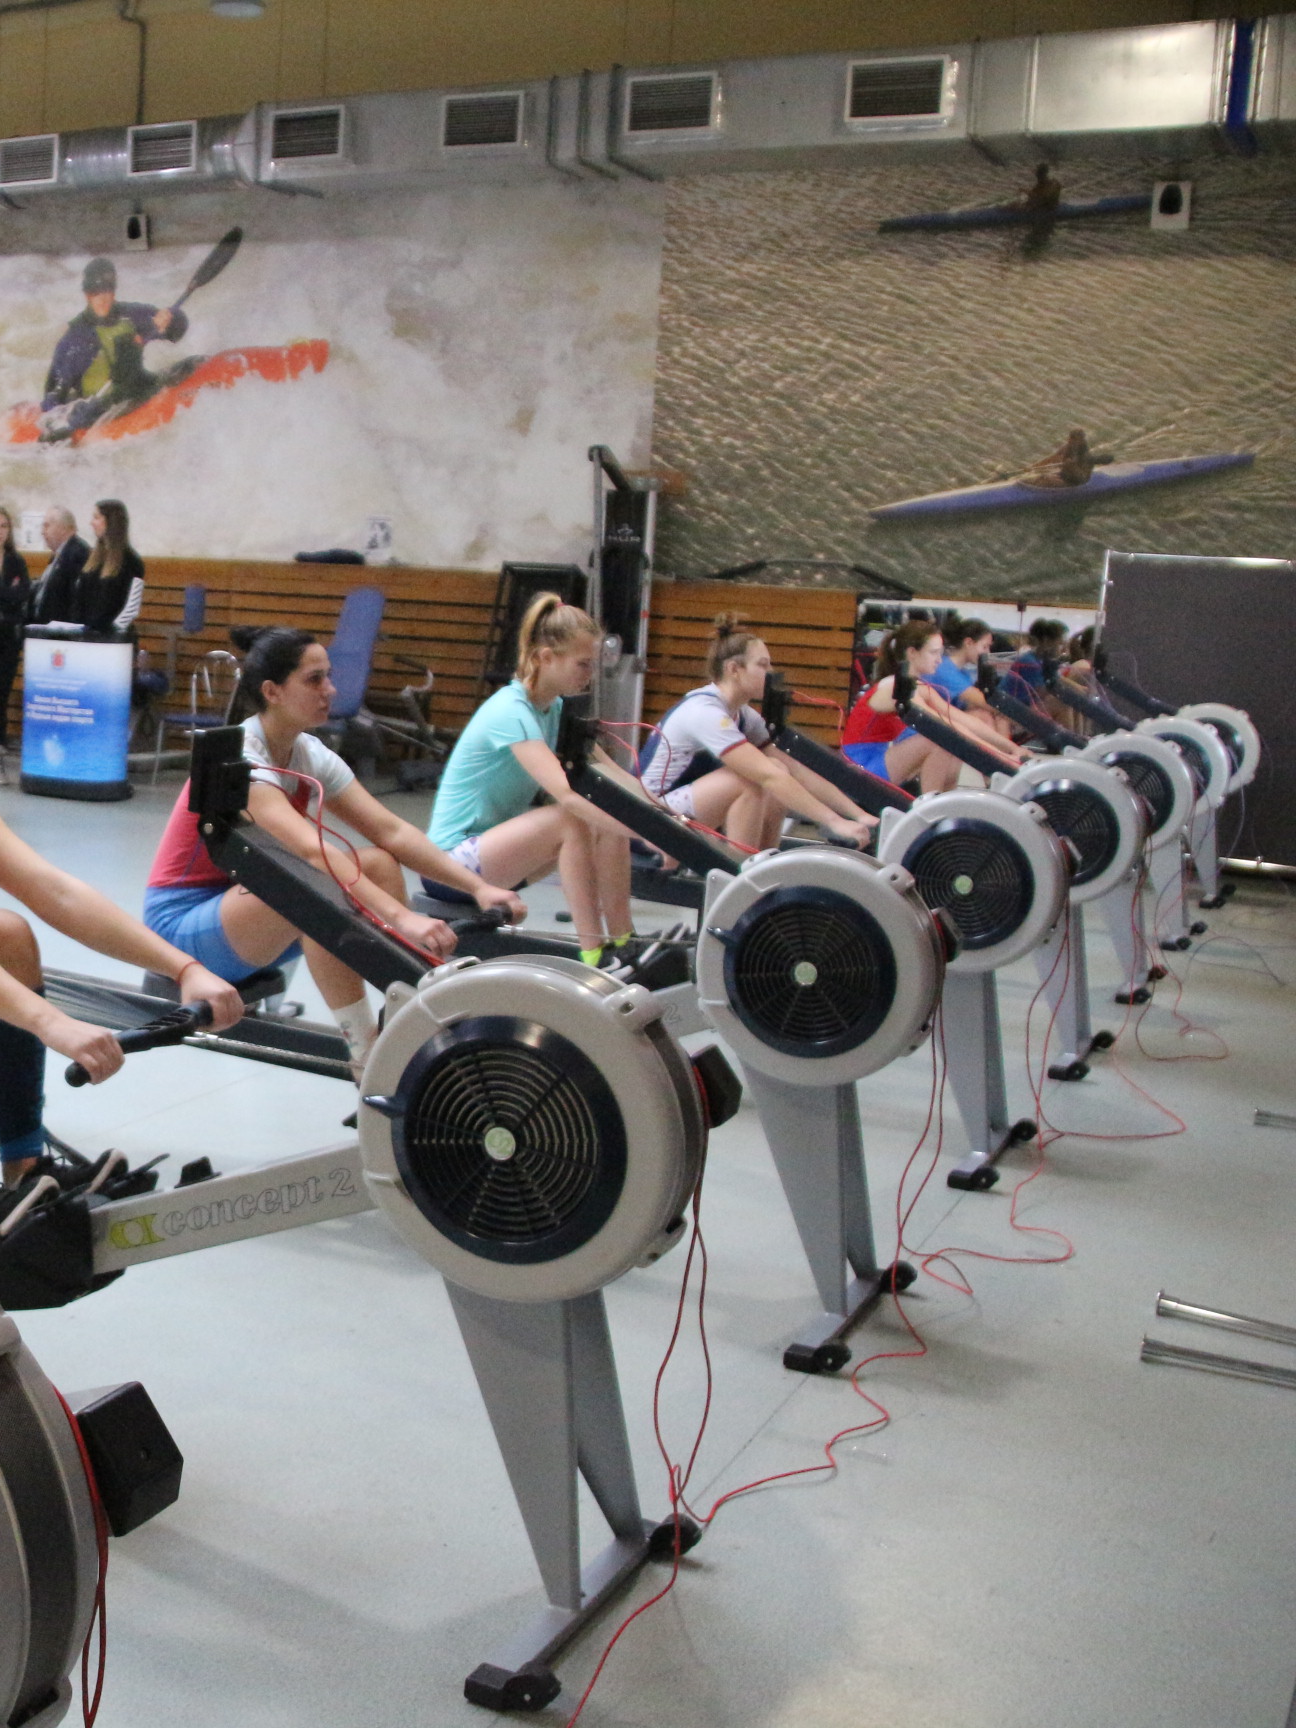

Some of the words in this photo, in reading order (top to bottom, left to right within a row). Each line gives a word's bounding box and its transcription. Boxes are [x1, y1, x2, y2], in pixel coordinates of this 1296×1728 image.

[664, 1004, 682, 1025] 2
[162, 1175, 324, 1237] concept
[328, 1167, 357, 1199] 2
